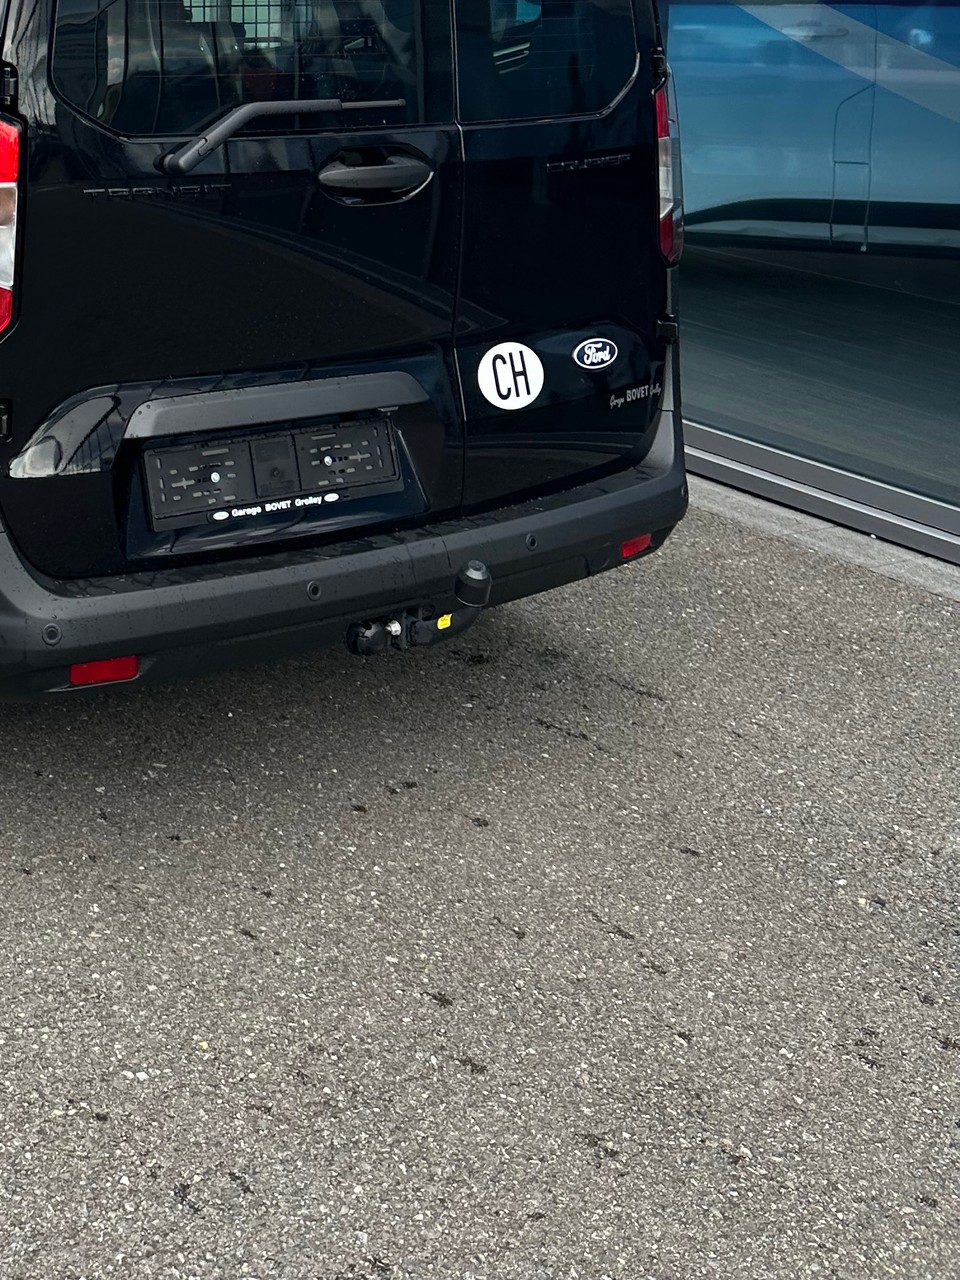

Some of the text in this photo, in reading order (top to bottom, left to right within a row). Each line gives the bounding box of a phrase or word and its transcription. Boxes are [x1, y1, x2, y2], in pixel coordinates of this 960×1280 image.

[583, 342, 611, 365] Ford
[492, 350, 531, 400] CH
[626, 385, 649, 402] BOVET
[231, 506, 262, 518] Garage
[264, 500, 292, 512] BOVET
[294, 496, 322, 508] Grolley
